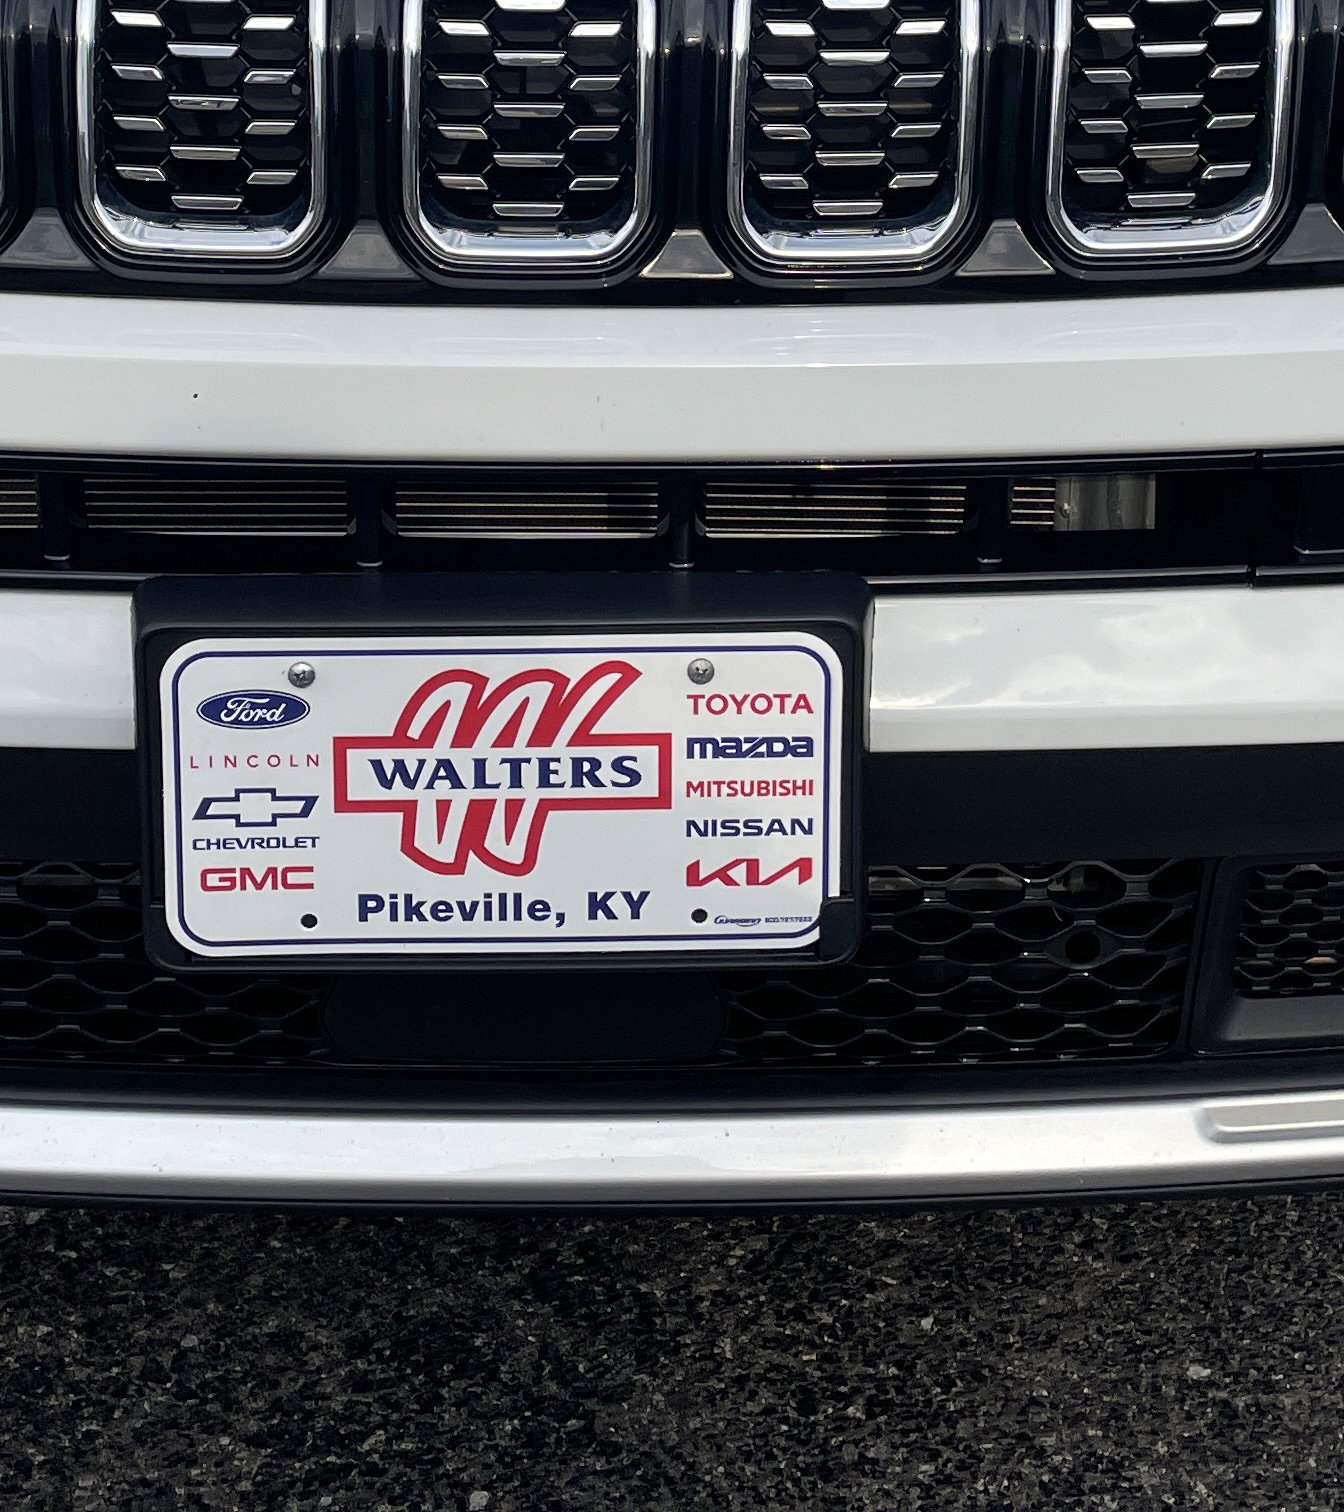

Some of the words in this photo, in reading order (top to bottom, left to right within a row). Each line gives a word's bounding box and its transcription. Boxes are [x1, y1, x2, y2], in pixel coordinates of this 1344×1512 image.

[220, 696, 287, 723] Ford
[686, 693, 814, 716] TOYOTA
[189, 753, 320, 769] LINCOLN
[367, 755, 642, 790] WALTERS
[686, 779, 814, 798] MITSUBISHI
[686, 817, 814, 838] NISSAN
[192, 836, 320, 851] CHEVROLET
[200, 866, 315, 892] GMC
[686, 857, 813, 887] KIA
[357, 892, 566, 928] Pikeville,
[587, 890, 651, 921] KY
